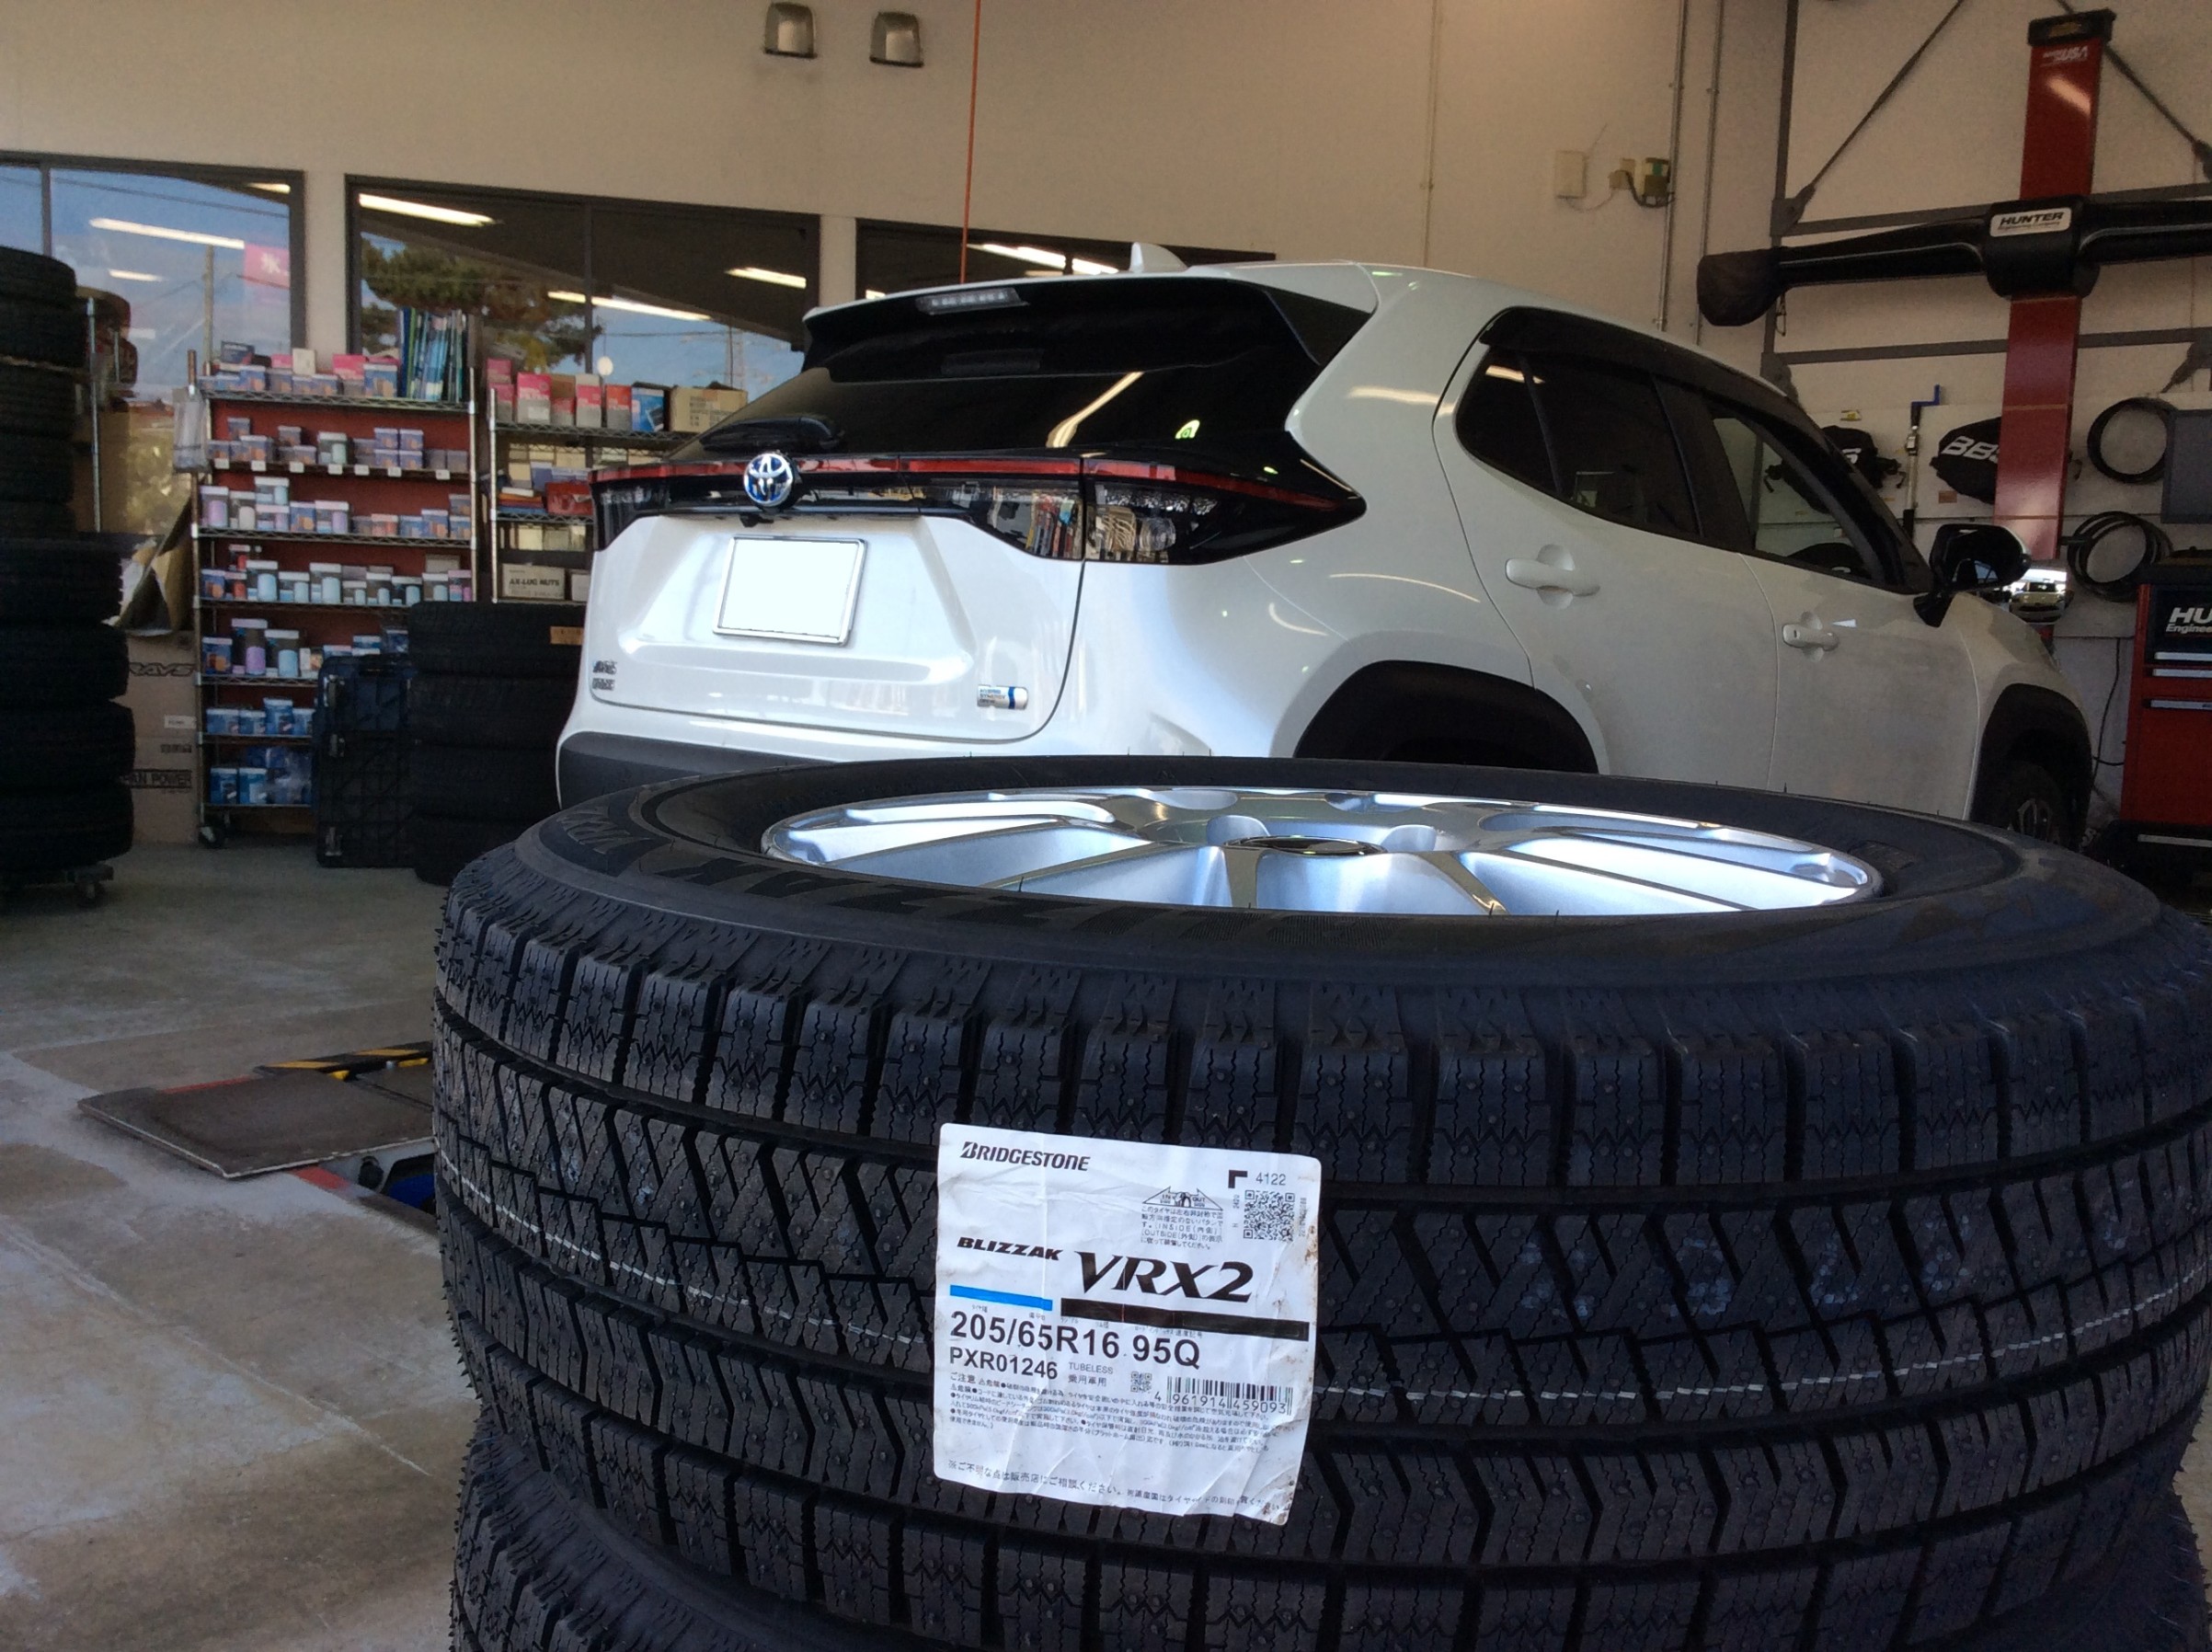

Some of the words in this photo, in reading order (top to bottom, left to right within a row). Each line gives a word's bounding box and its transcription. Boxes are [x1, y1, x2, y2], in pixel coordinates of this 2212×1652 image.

[2000, 212, 2065, 226] HUNTER
[960, 1141, 1091, 1171] BRIDGESTONE
[1255, 1172, 1287, 1186] 4122
[957, 1236, 1063, 1261] BLIZZAK
[1074, 1251, 1254, 1302] VRX2
[950, 1311, 1119, 1359] 205/65R16
[1132, 1335, 1200, 1370] 95Q
[950, 1347, 1058, 1380] PXR01246
[1068, 1361, 1114, 1374] TUBELESS
[1172, 1394, 1226, 1409] 961914
[1232, 1400, 1287, 1415] 459093
